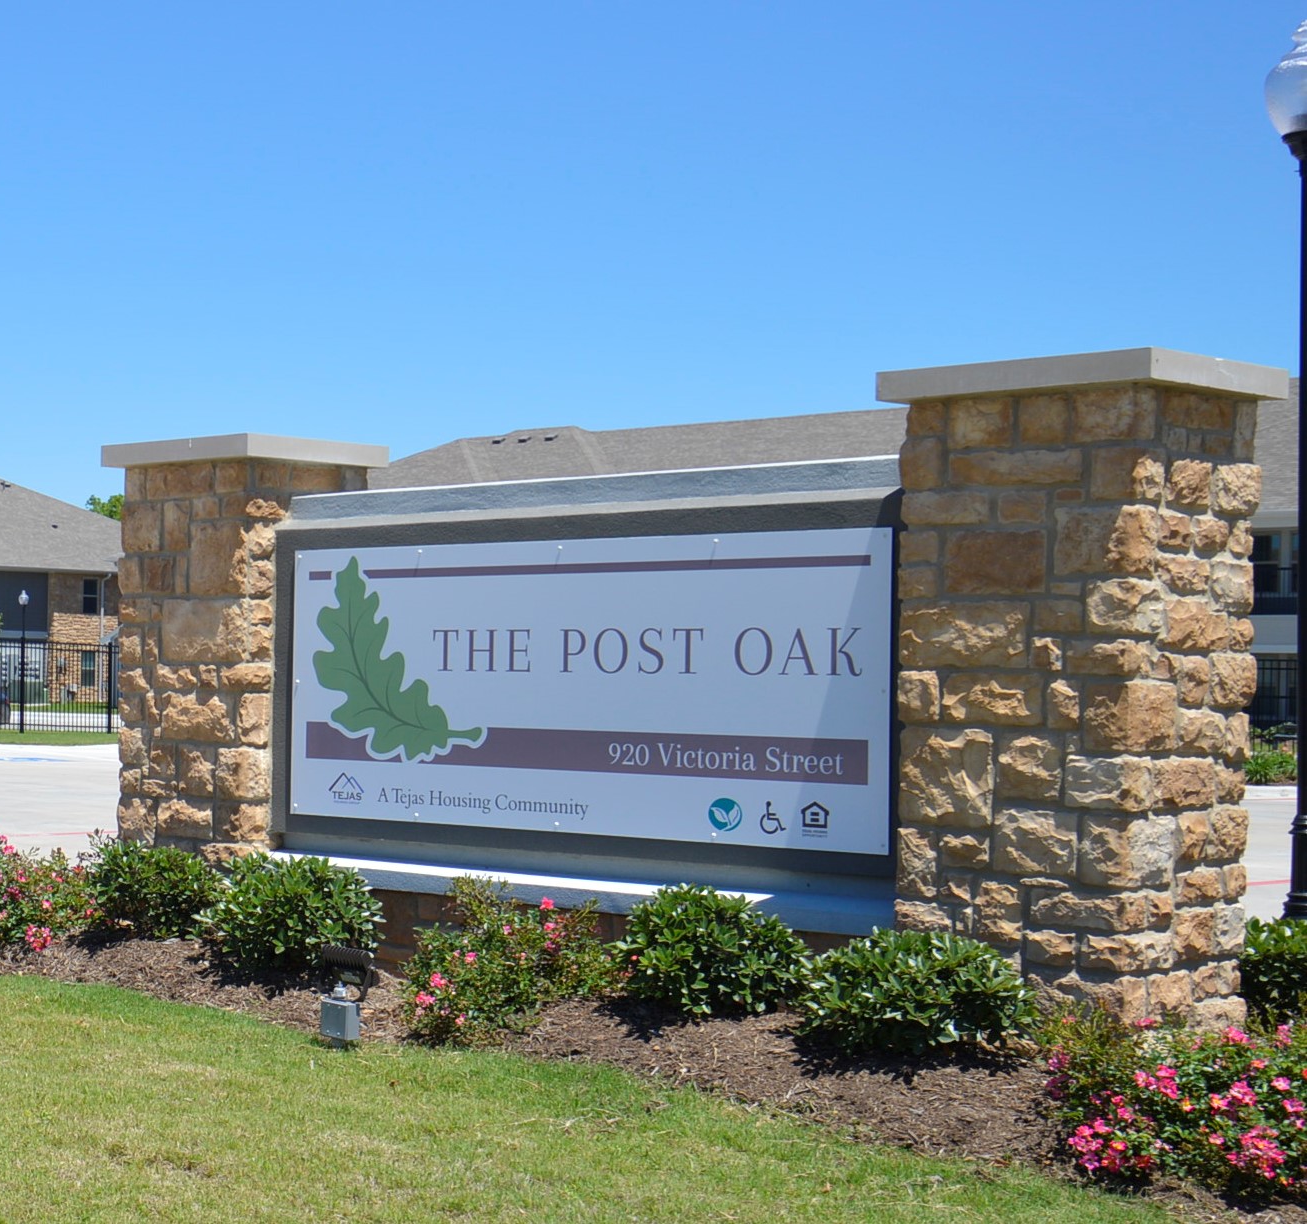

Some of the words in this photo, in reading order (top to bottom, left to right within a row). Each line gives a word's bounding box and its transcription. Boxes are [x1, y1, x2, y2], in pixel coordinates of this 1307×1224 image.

[432, 629, 531, 672] THE
[560, 628, 704, 674] POST
[734, 627, 863, 676] OAK
[608, 743, 650, 766] 920
[658, 743, 757, 772] Victoria
[765, 747, 843, 776] Street
[332, 790, 362, 801] TEJAS
[378, 787, 390, 803] A
[391, 788, 425, 809] Tejas
[429, 790, 491, 814] Housing
[495, 794, 589, 820] Community
